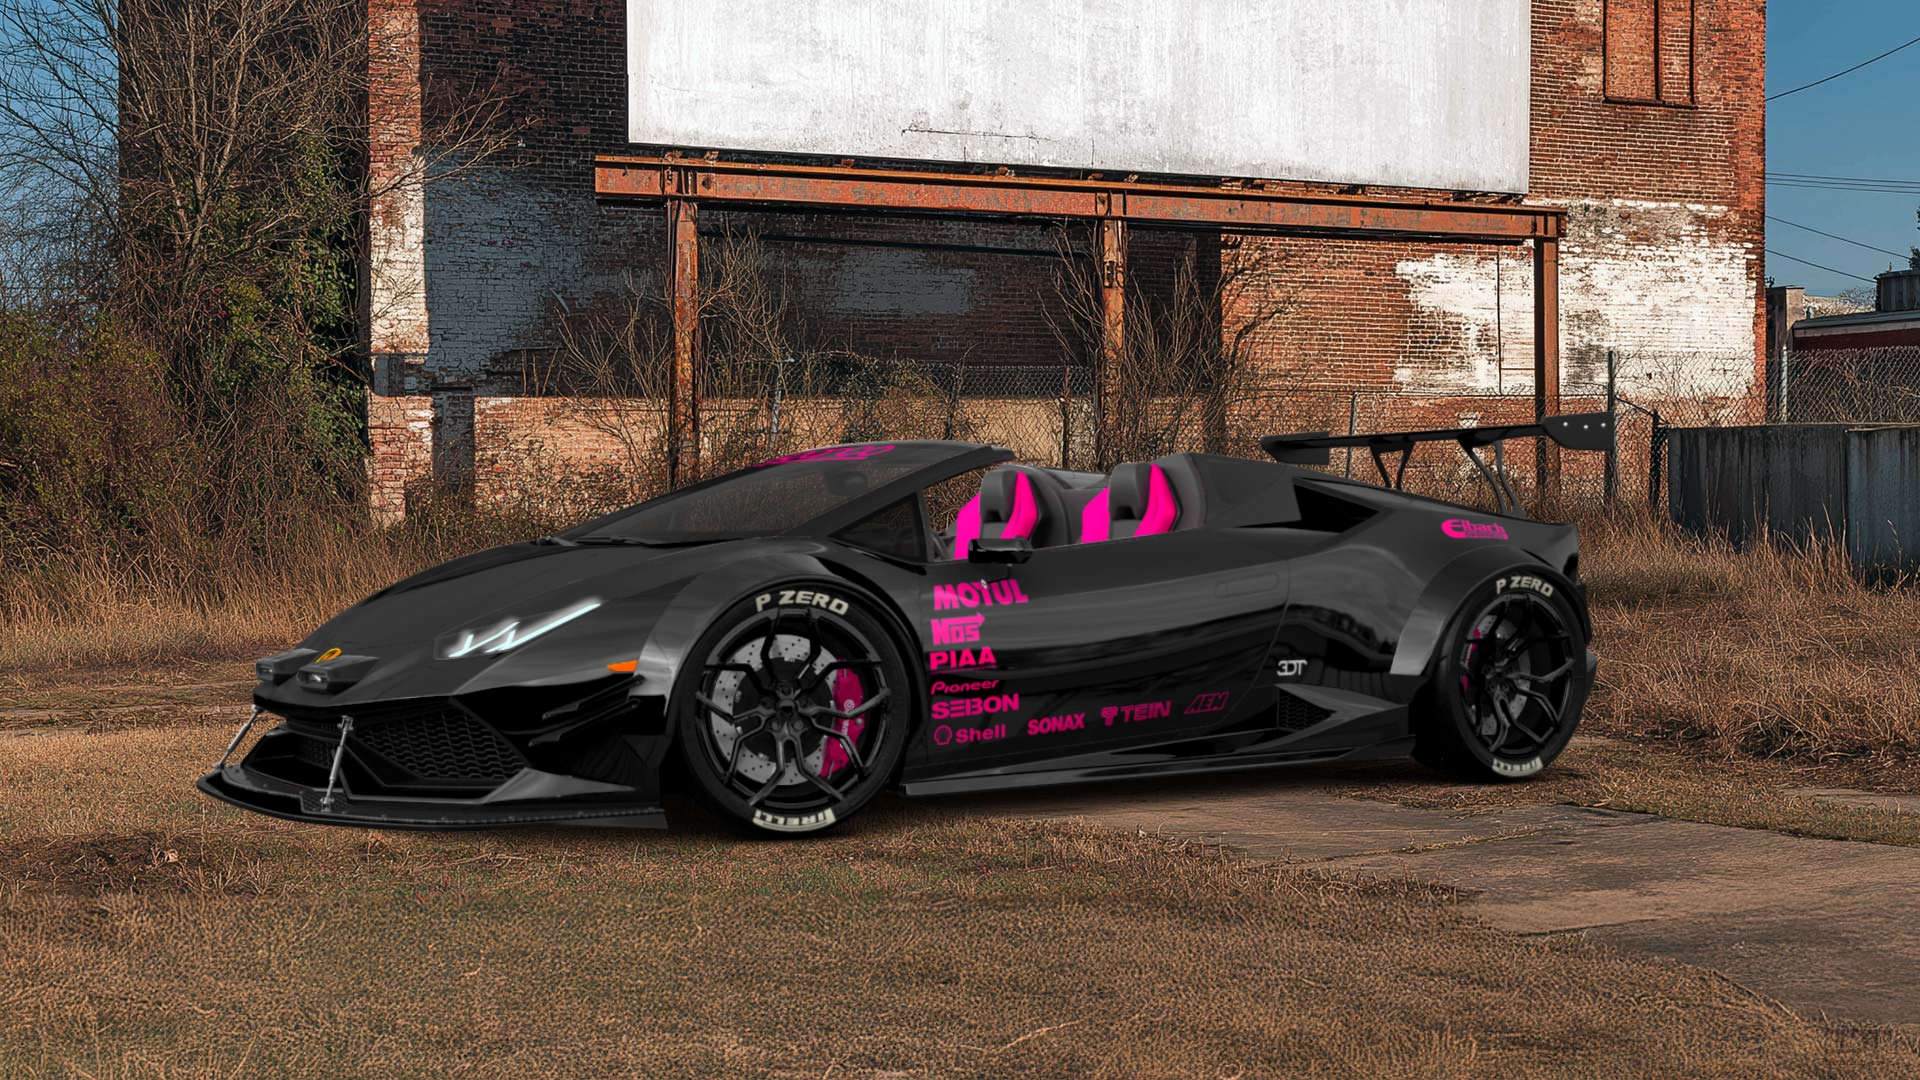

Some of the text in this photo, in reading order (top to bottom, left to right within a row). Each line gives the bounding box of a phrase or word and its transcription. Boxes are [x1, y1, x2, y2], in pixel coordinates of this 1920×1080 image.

[1441, 518, 1508, 540] Eibach
[934, 578, 1029, 611] MOTUL
[1496, 575, 1553, 597] P ZERO
[755, 590, 849, 615] P ZERO
[929, 646, 997, 670] PIAA
[930, 679, 1000, 695] Pioneer
[931, 693, 1020, 720] SEBON
[1120, 700, 1171, 723] TEIN
[955, 723, 1006, 744] Shell
[1027, 712, 1086, 736] SONAX
[752, 807, 836, 832] PIRELLI
